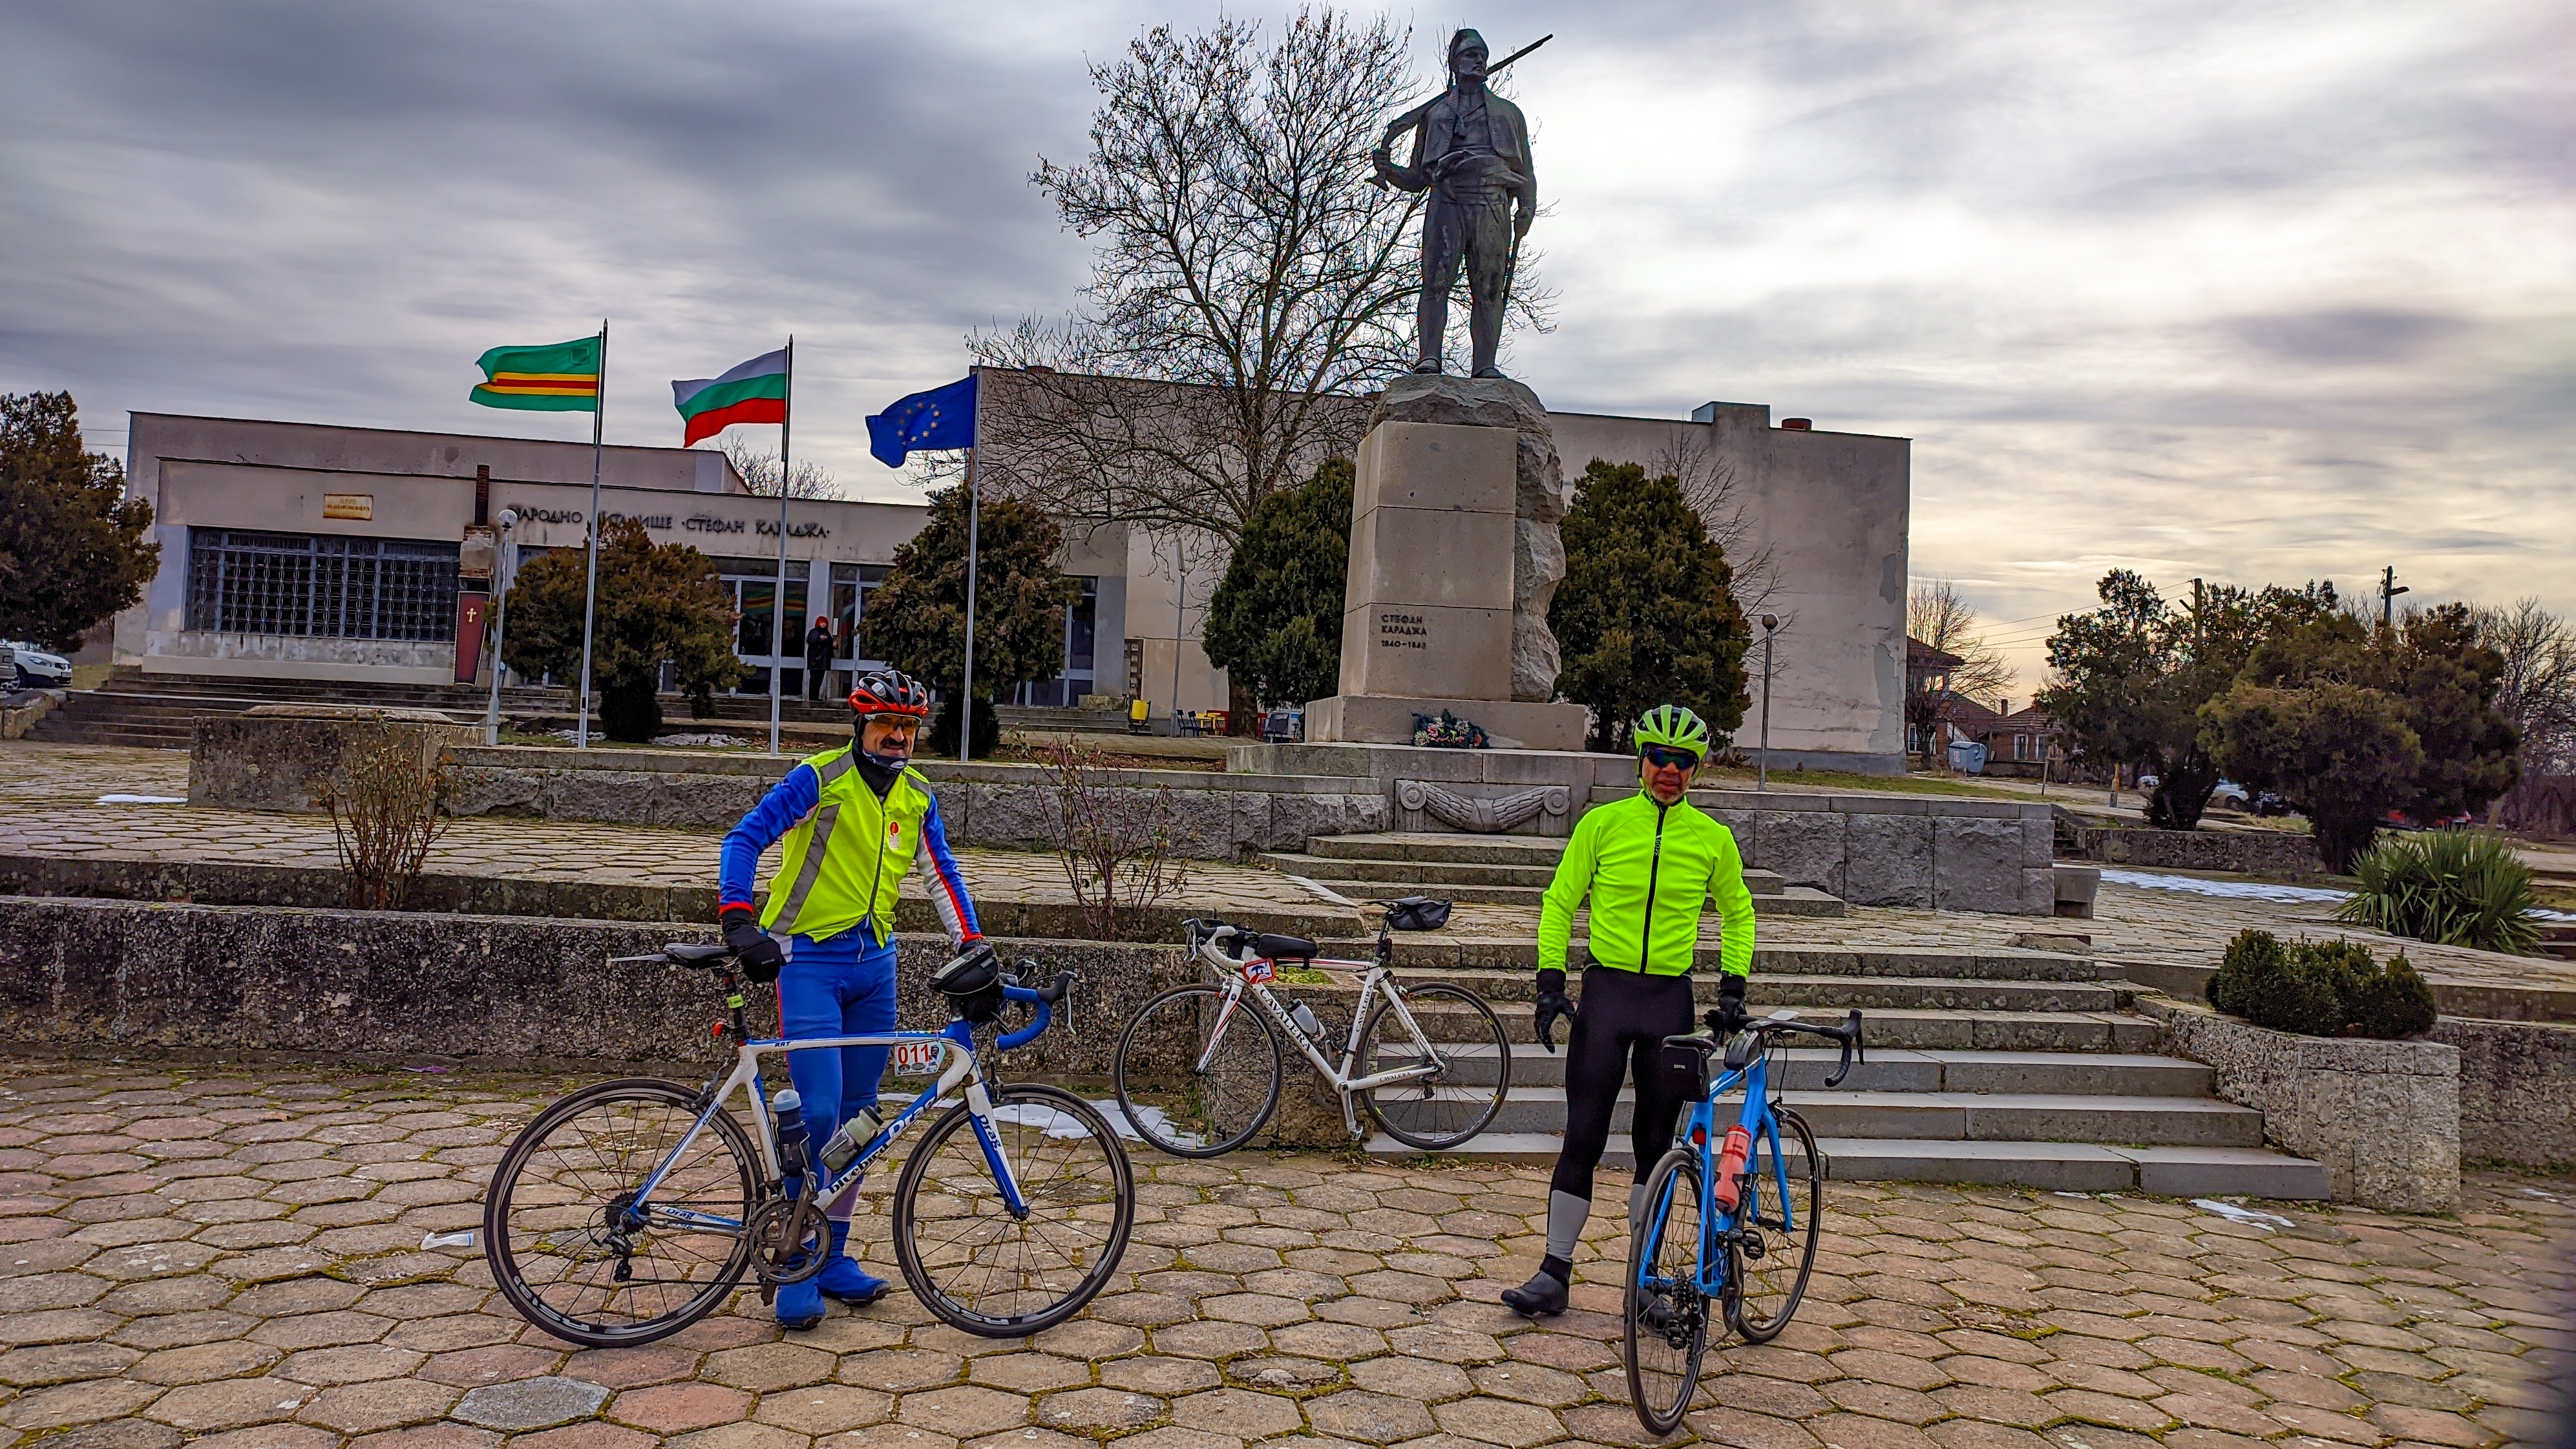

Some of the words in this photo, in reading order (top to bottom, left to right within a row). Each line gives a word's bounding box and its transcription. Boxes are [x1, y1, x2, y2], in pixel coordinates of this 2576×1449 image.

[1381, 615, 1423, 624] СТЕФАН
[1382, 625, 1427, 635] КАРАДЖА
[1356, 984, 1373, 1032] CAVALERA
[1260, 989, 1311, 1052] CAVALERA
[1379, 1072, 1412, 1082] CAVALERA
[979, 1114, 1002, 1148] Drag
[829, 1143, 889, 1194] bluebird
[666, 1208, 693, 1220] Drag
